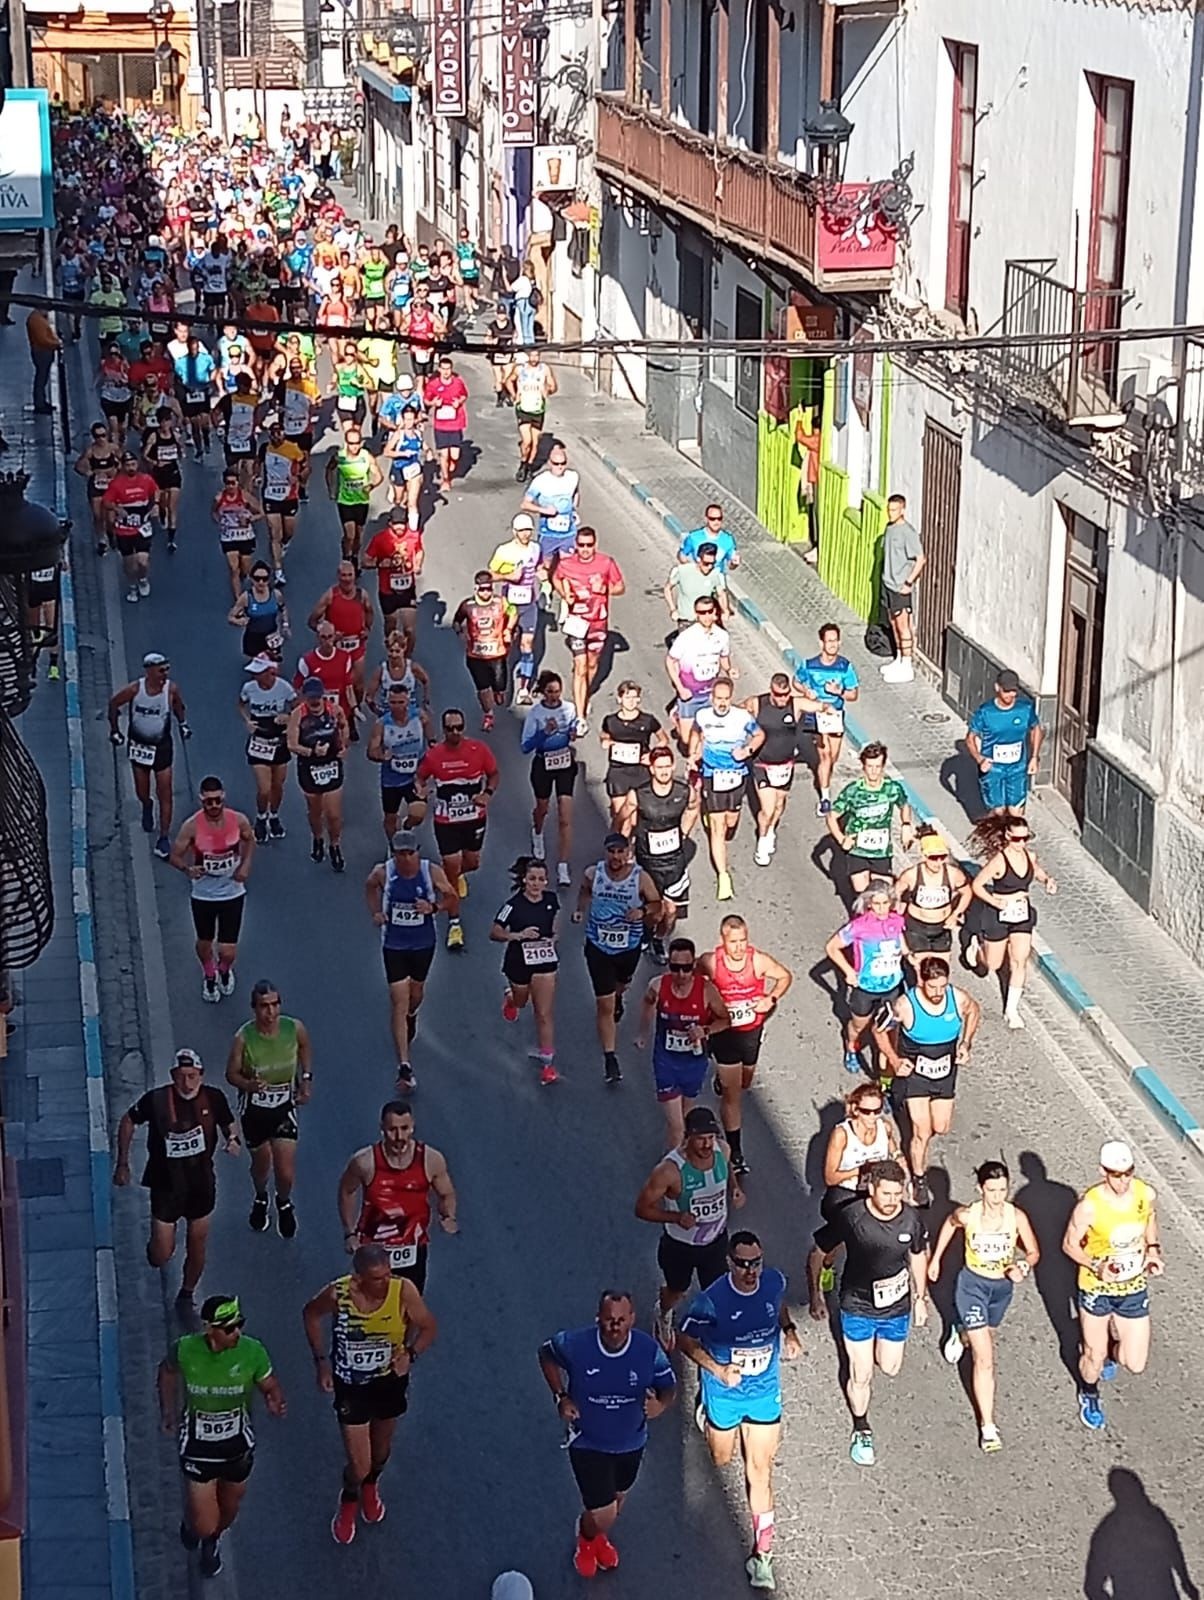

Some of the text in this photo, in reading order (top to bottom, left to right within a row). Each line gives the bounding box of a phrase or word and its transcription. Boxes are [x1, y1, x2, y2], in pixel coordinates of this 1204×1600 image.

[518, 3, 534, 115] MLINO
[502, 35, 519, 128] VIEJO
[205, 859, 232, 871] 1241
[601, 931, 625, 943] 789
[526, 947, 554, 960] 2105
[171, 1138, 199, 1152] 238
[388, 1247, 411, 1262] 06
[353, 1350, 385, 1364] 675
